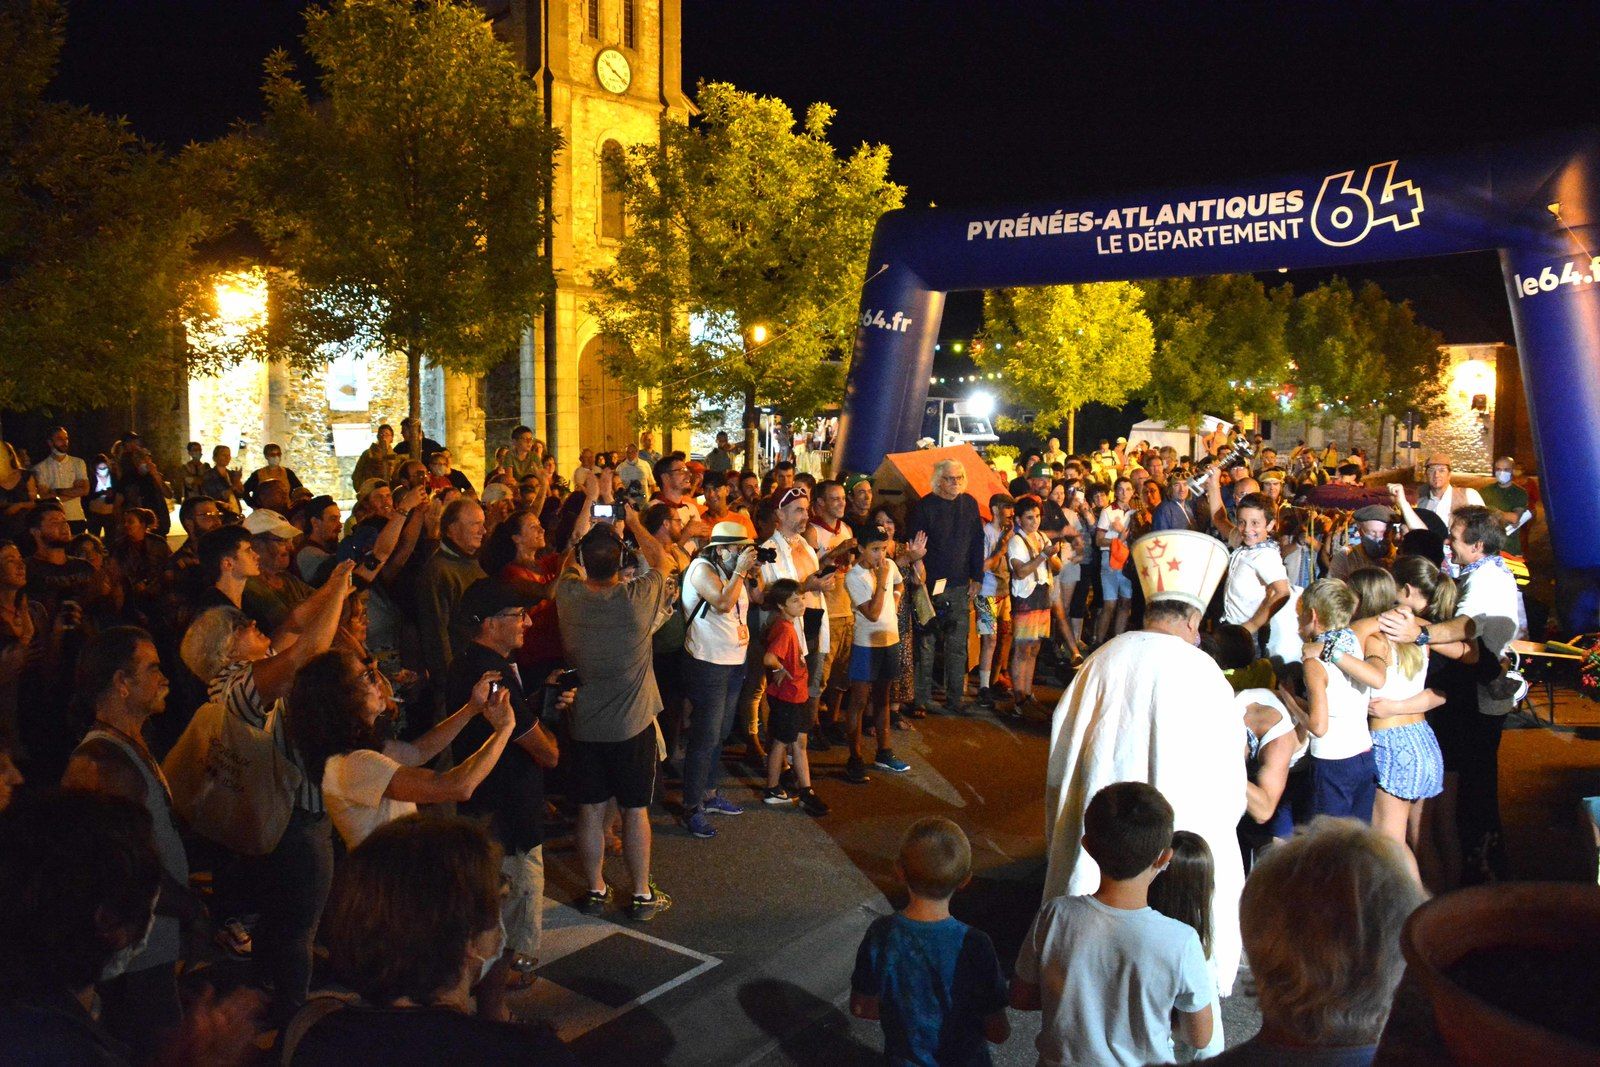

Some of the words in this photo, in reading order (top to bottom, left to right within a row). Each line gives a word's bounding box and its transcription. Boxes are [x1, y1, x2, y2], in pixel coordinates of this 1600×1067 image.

[967, 190, 1304, 240] PYRÉNÉES-ATLANTIQUES
[1310, 160, 1424, 247] 64
[1096, 234, 1123, 255] LE
[1128, 218, 1304, 252] DÉPARTEMENT
